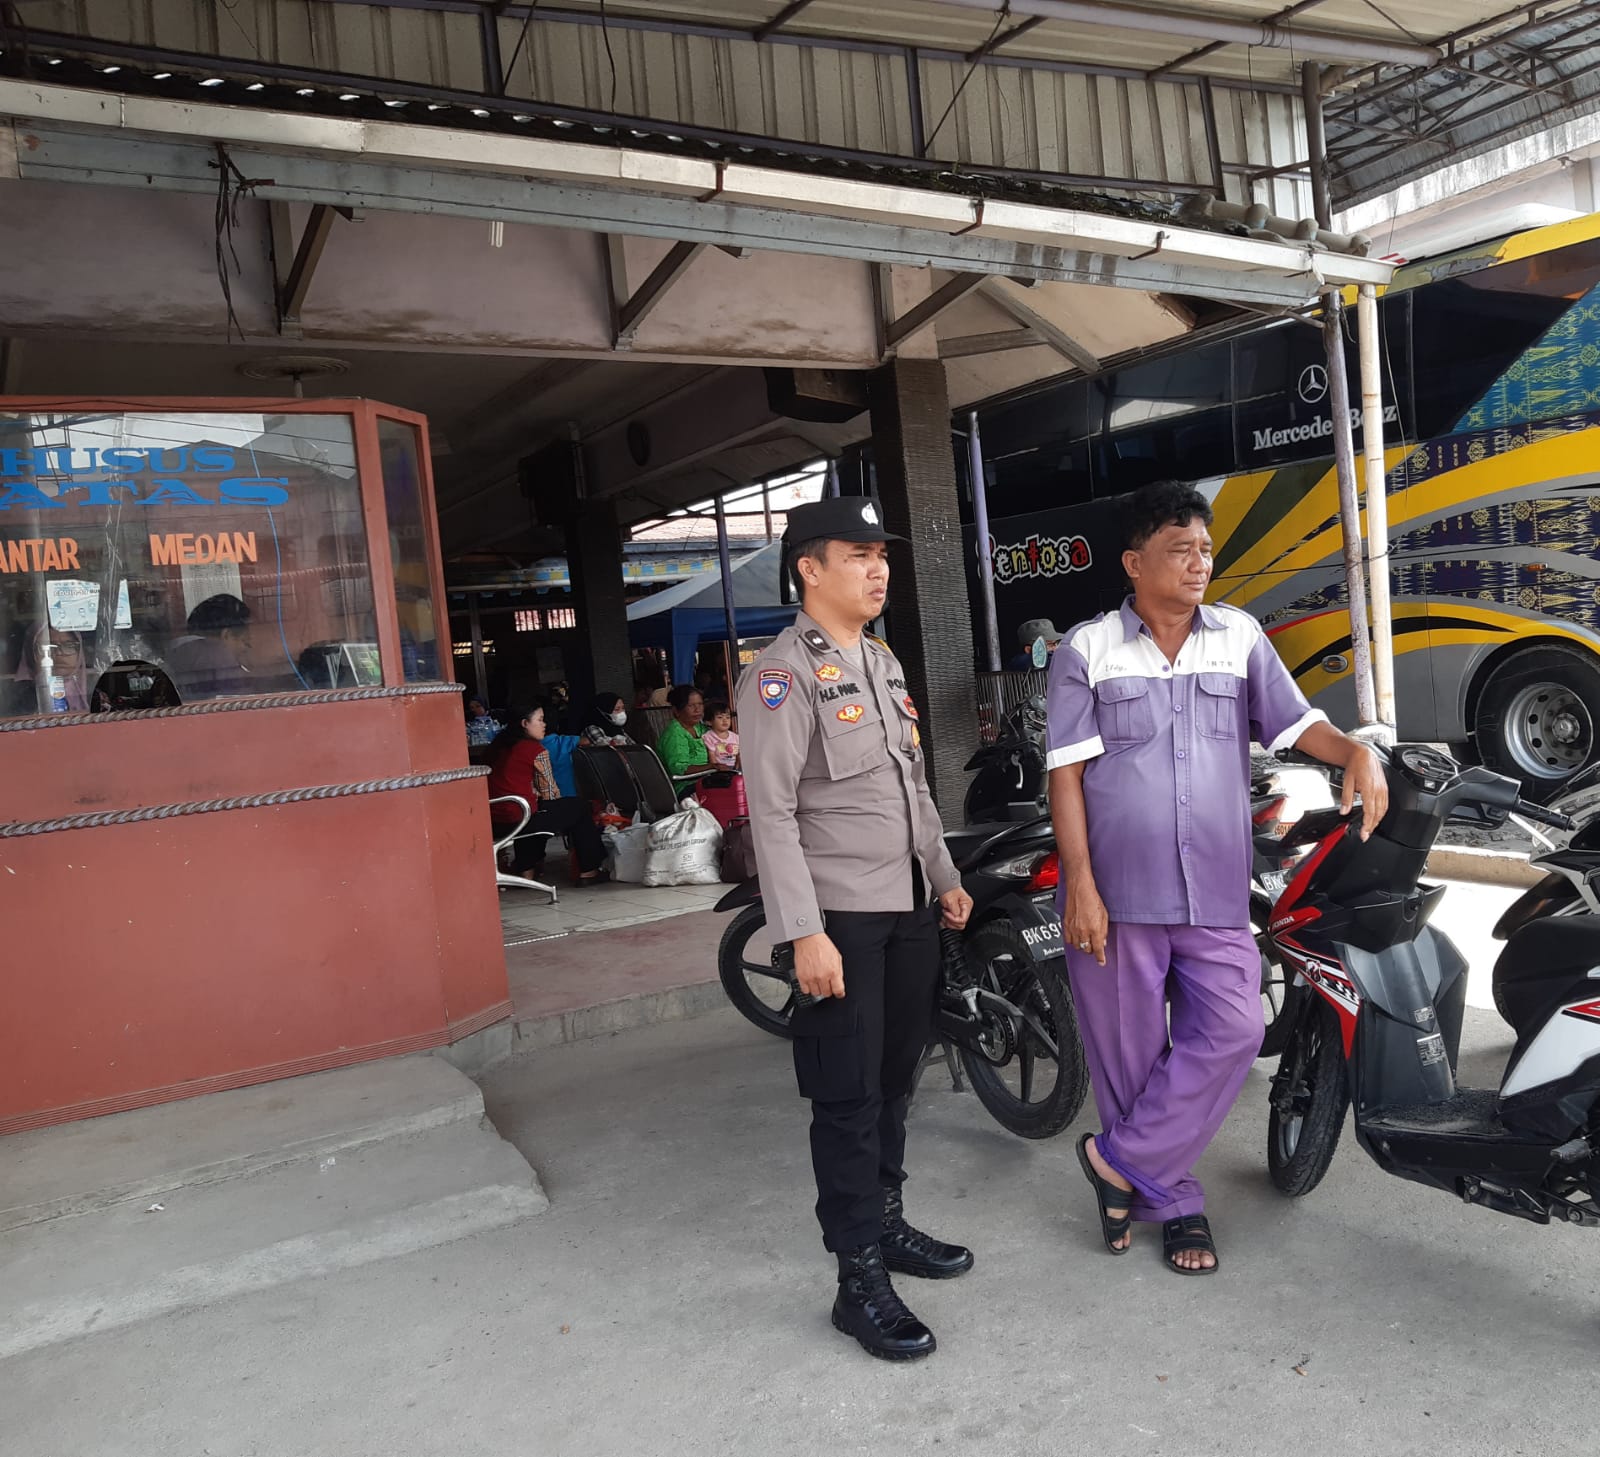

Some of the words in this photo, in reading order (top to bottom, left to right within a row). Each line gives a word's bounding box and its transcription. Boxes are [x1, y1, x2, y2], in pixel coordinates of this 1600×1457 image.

[0, 537, 81, 574] ANTAR
[149, 531, 258, 566] MEDAN
[975, 533, 1093, 584] entosa
